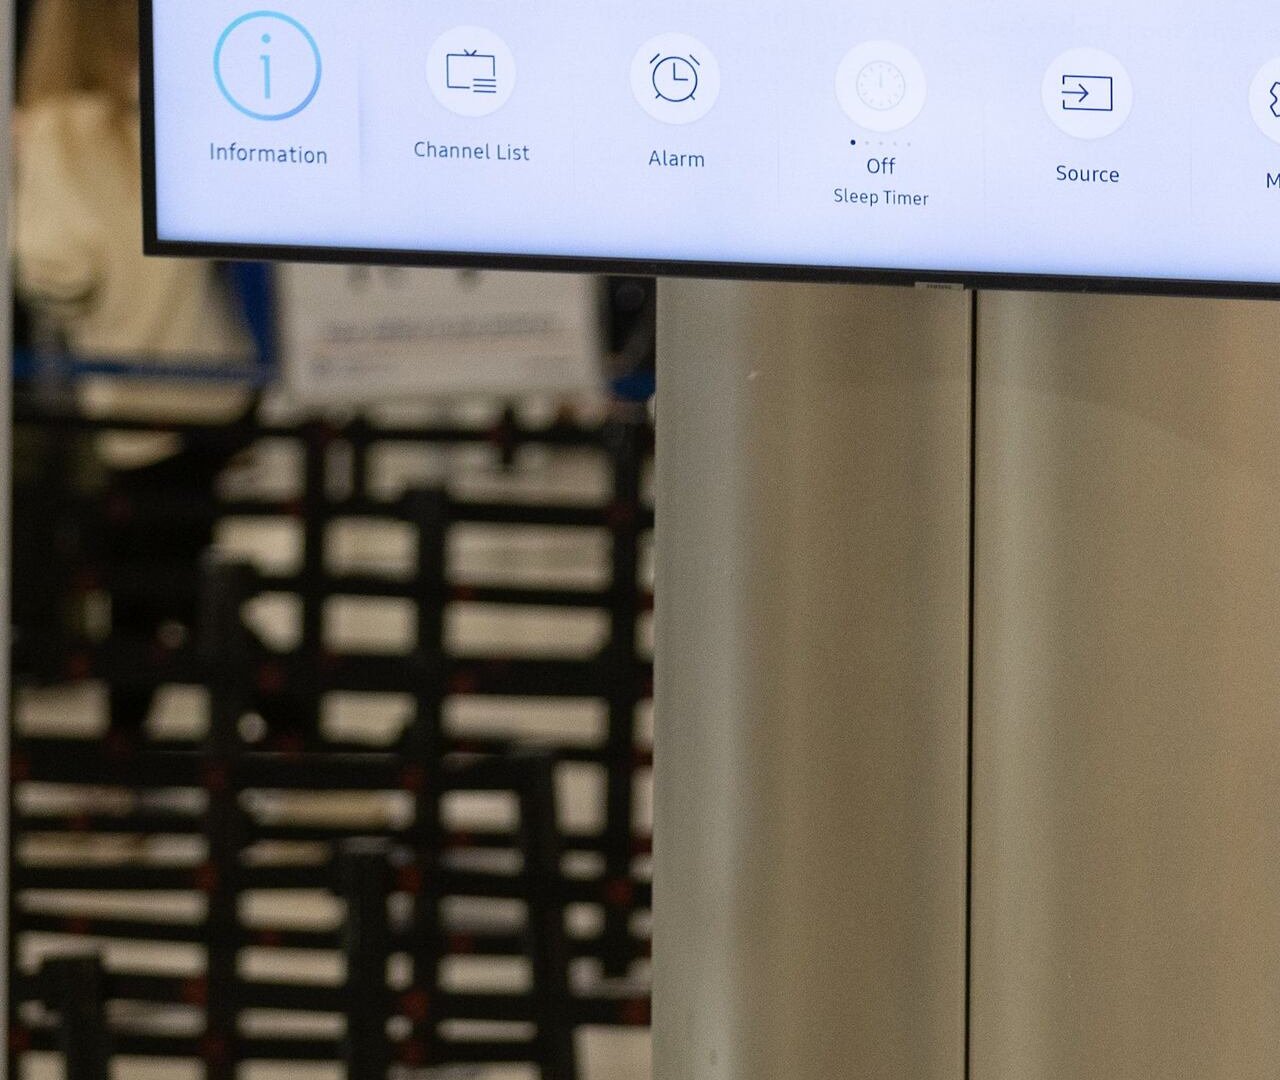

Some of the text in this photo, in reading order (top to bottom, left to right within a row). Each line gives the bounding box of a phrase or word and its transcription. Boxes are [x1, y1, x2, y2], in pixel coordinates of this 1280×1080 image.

[209, 142, 327, 165] Information
[414, 141, 530, 161] Channel List
[648, 150, 705, 168] Alarm
[867, 156, 896, 175] Off
[1056, 165, 1120, 184] Source
[834, 188, 929, 207] Sleep Timer
